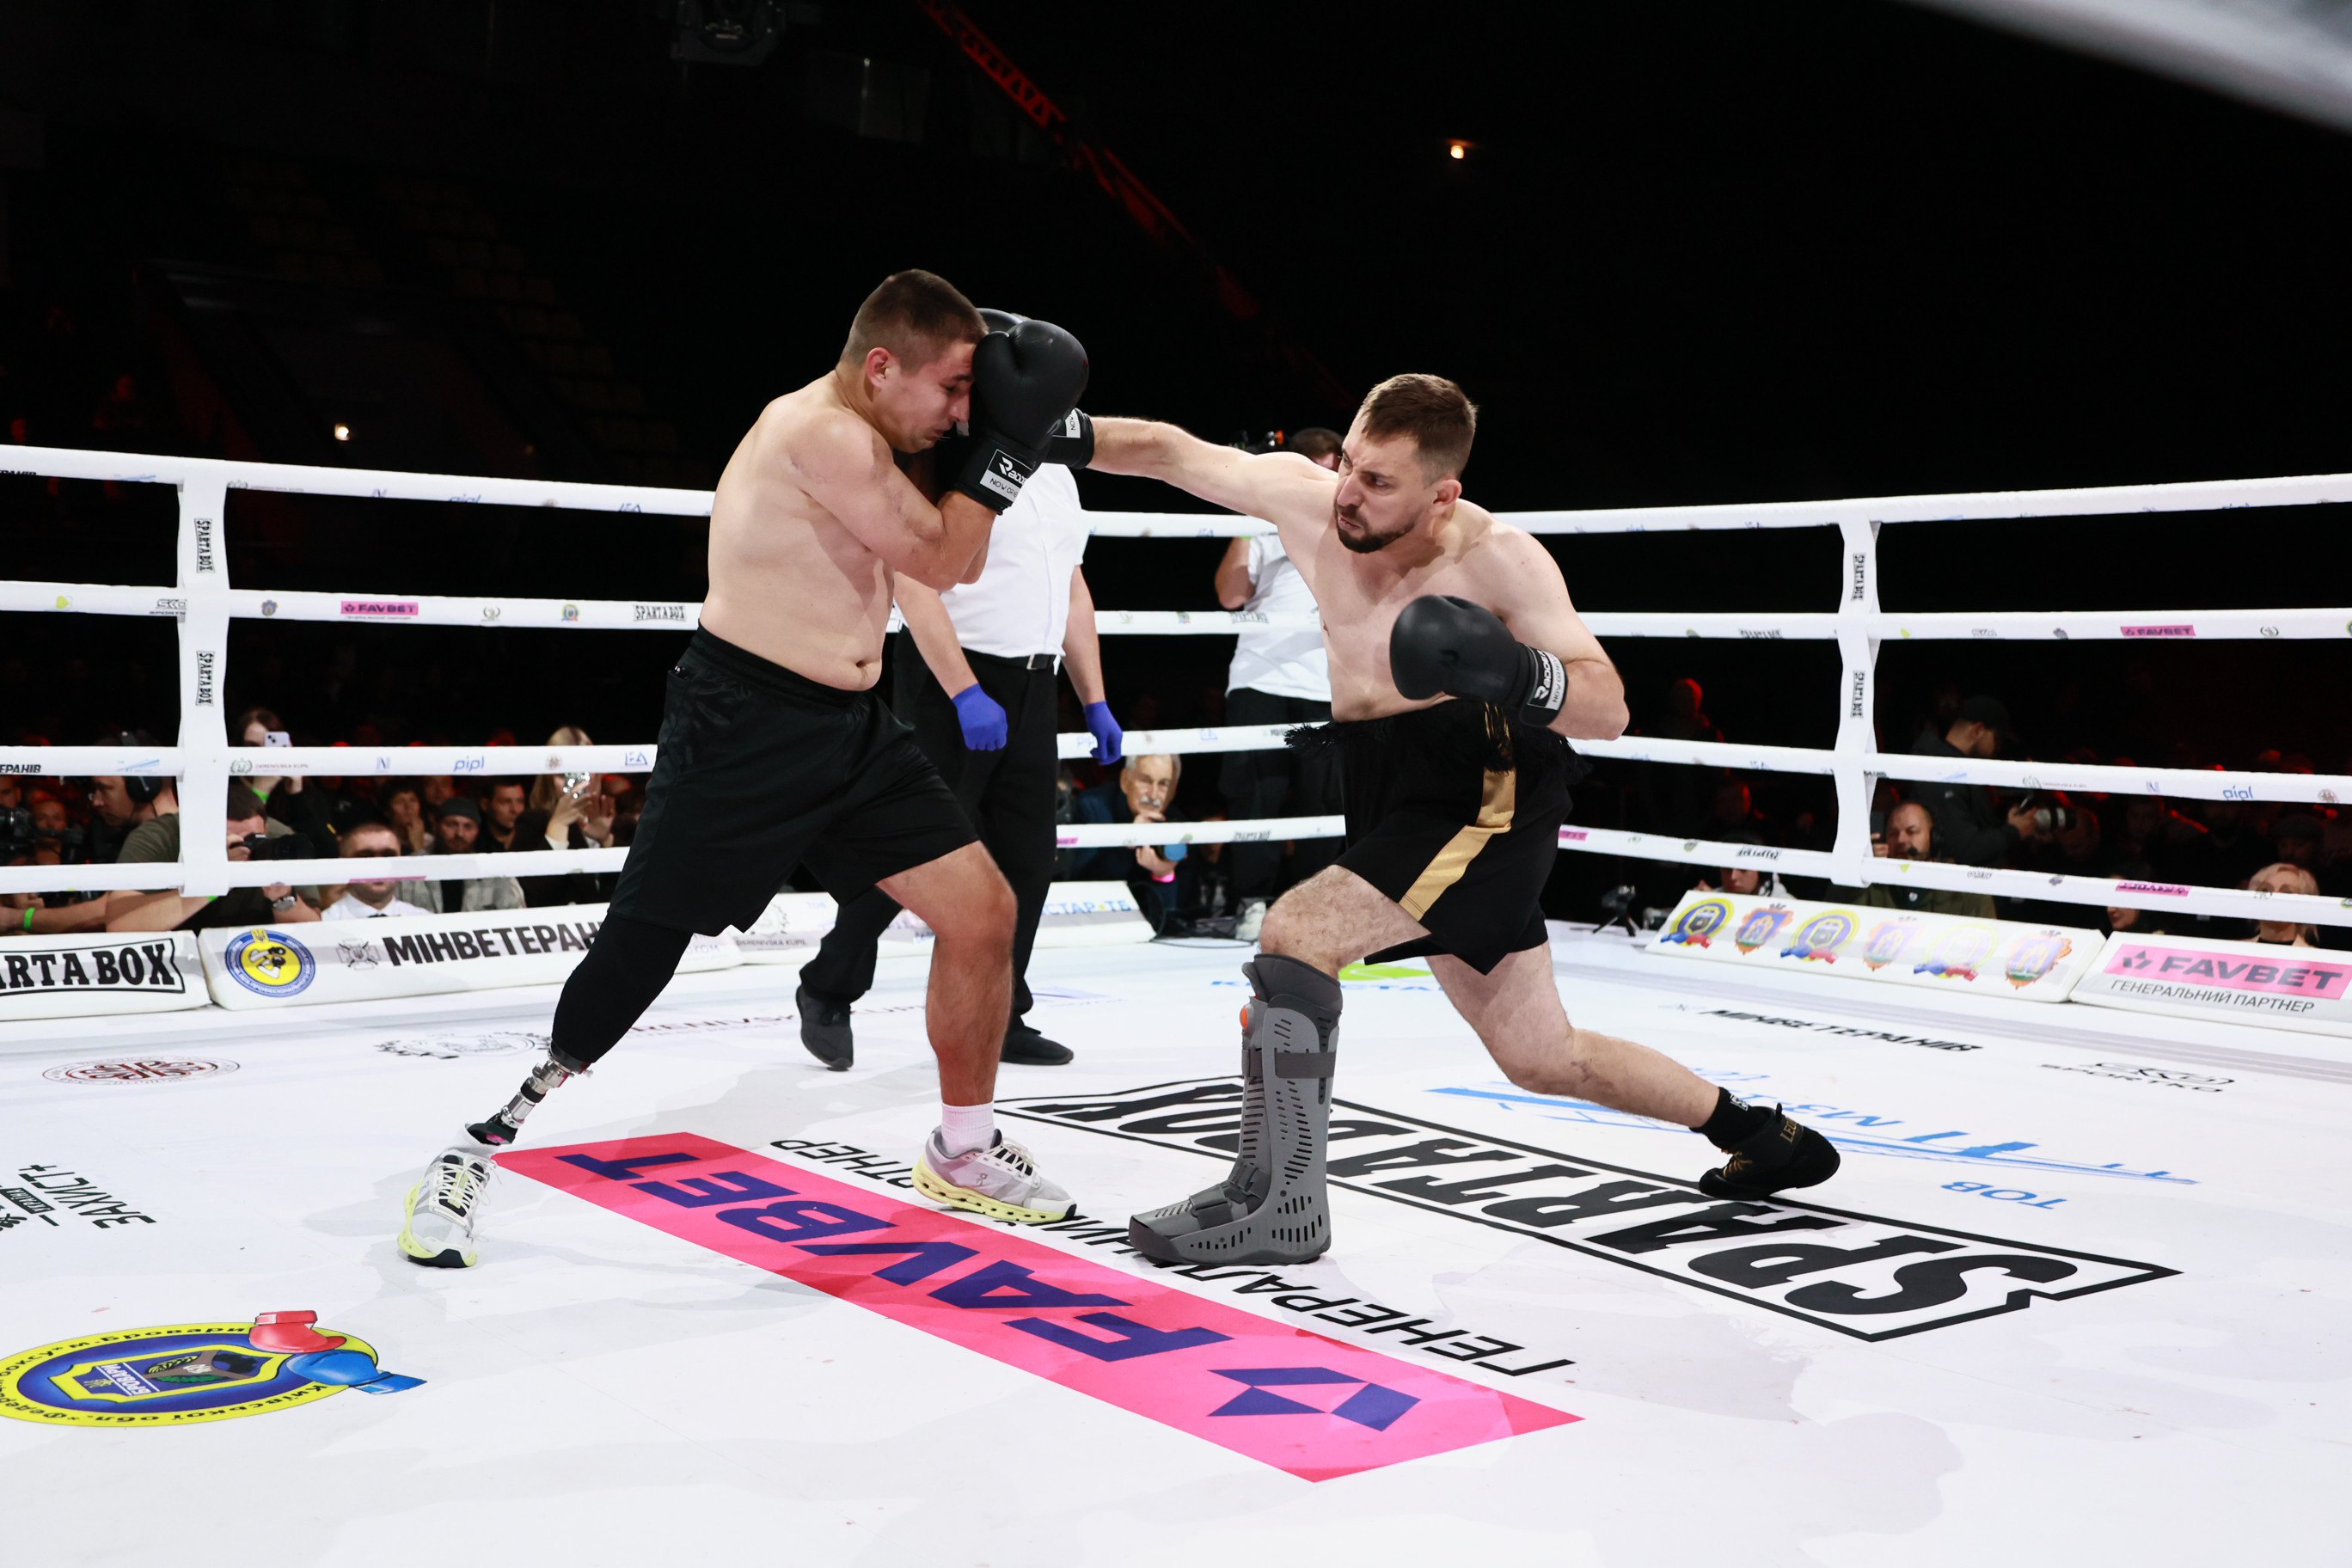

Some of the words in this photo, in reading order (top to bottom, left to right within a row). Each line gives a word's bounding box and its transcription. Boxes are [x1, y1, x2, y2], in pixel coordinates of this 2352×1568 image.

[989, 477, 1008, 491] NOW
[358, 604, 415, 614] FAVBET
[454, 756, 485, 772] pipl
[383, 920, 603, 967] МІНВЕТЕРАН
[91, 943, 175, 986] BOX
[2159, 954, 2343, 990] FAVBET
[2110, 978, 2233, 1005] ГЕНЕРАЛЬНИЙ
[2233, 992, 2316, 1014] ПАРТНЕР
[1940, 1180, 2069, 1210] ТОВ
[1327, 1136, 2078, 1316] SPARTA
[555, 1151, 1235, 1362] FAVBET
